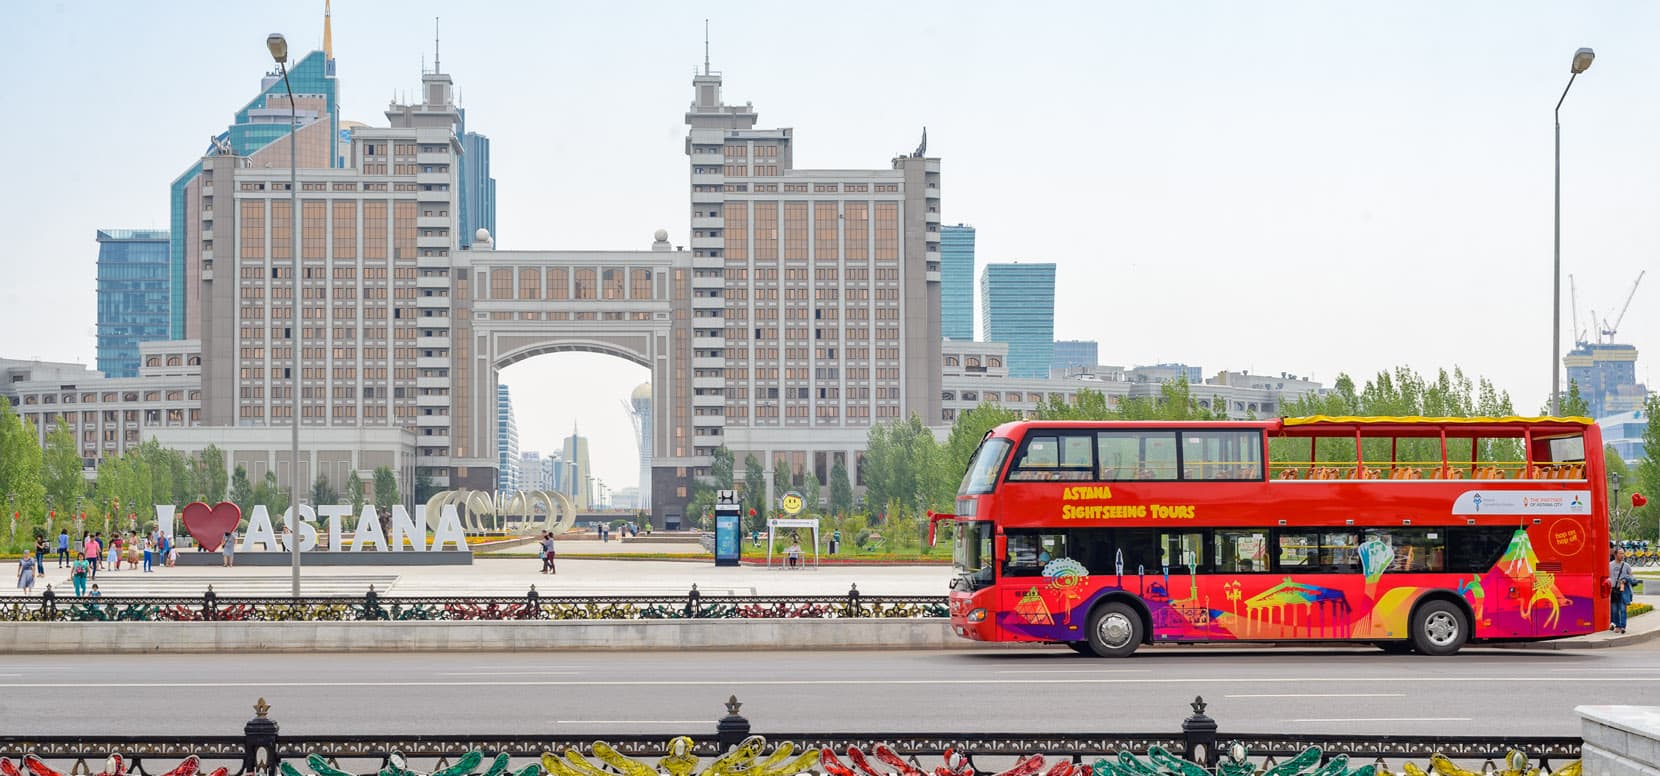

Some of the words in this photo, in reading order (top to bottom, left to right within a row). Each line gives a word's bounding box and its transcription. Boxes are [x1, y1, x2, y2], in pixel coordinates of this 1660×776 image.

[1063, 486, 1112, 500] ASTANA
[1062, 505, 1146, 519] SIGHTSEEING
[1150, 505, 1195, 519] TOURS
[241, 505, 469, 552] ASTANA
